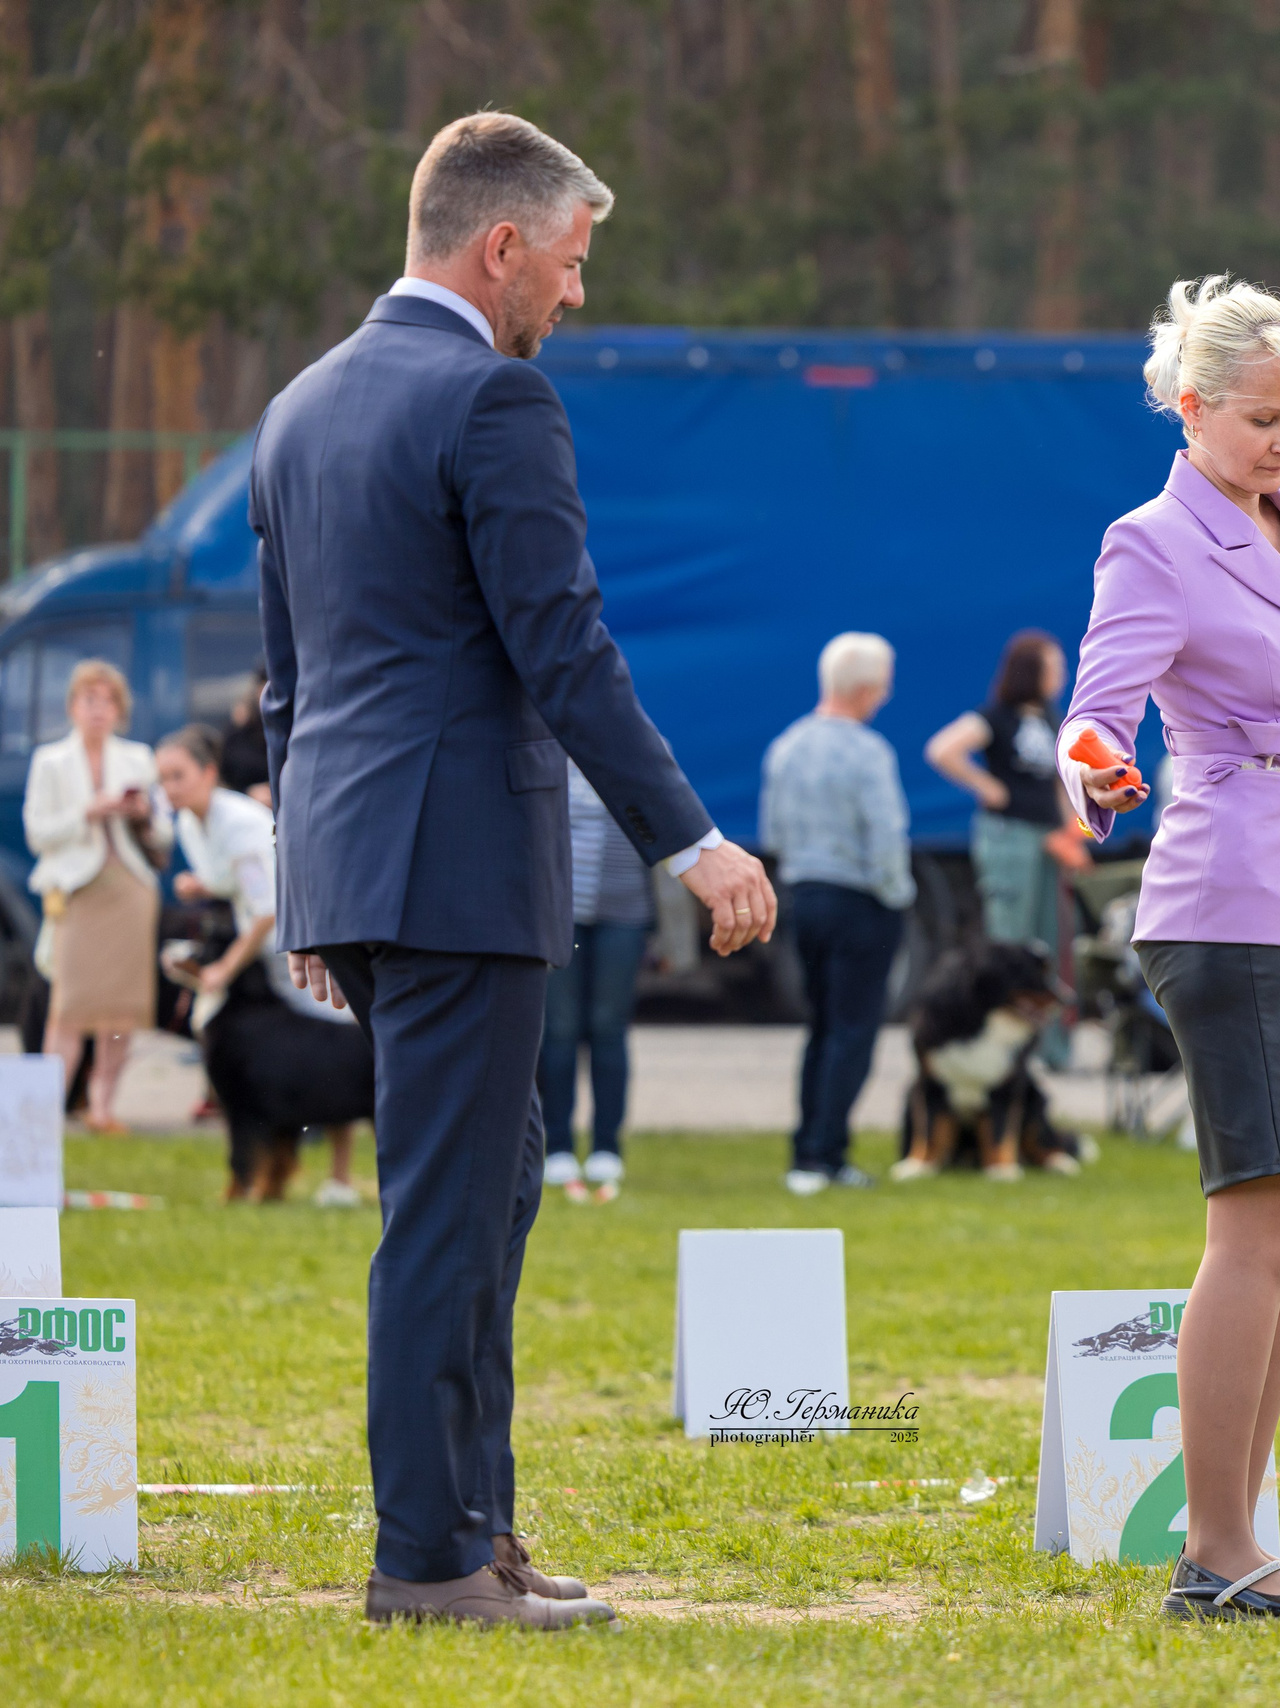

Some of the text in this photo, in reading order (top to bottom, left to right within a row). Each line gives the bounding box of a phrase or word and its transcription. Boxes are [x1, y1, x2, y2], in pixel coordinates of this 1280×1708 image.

[18, 1307, 126, 1353] РФОС
[63, 1359, 126, 1367] СОБАКОВОДСТВА
[0, 1380, 61, 1562] 1
